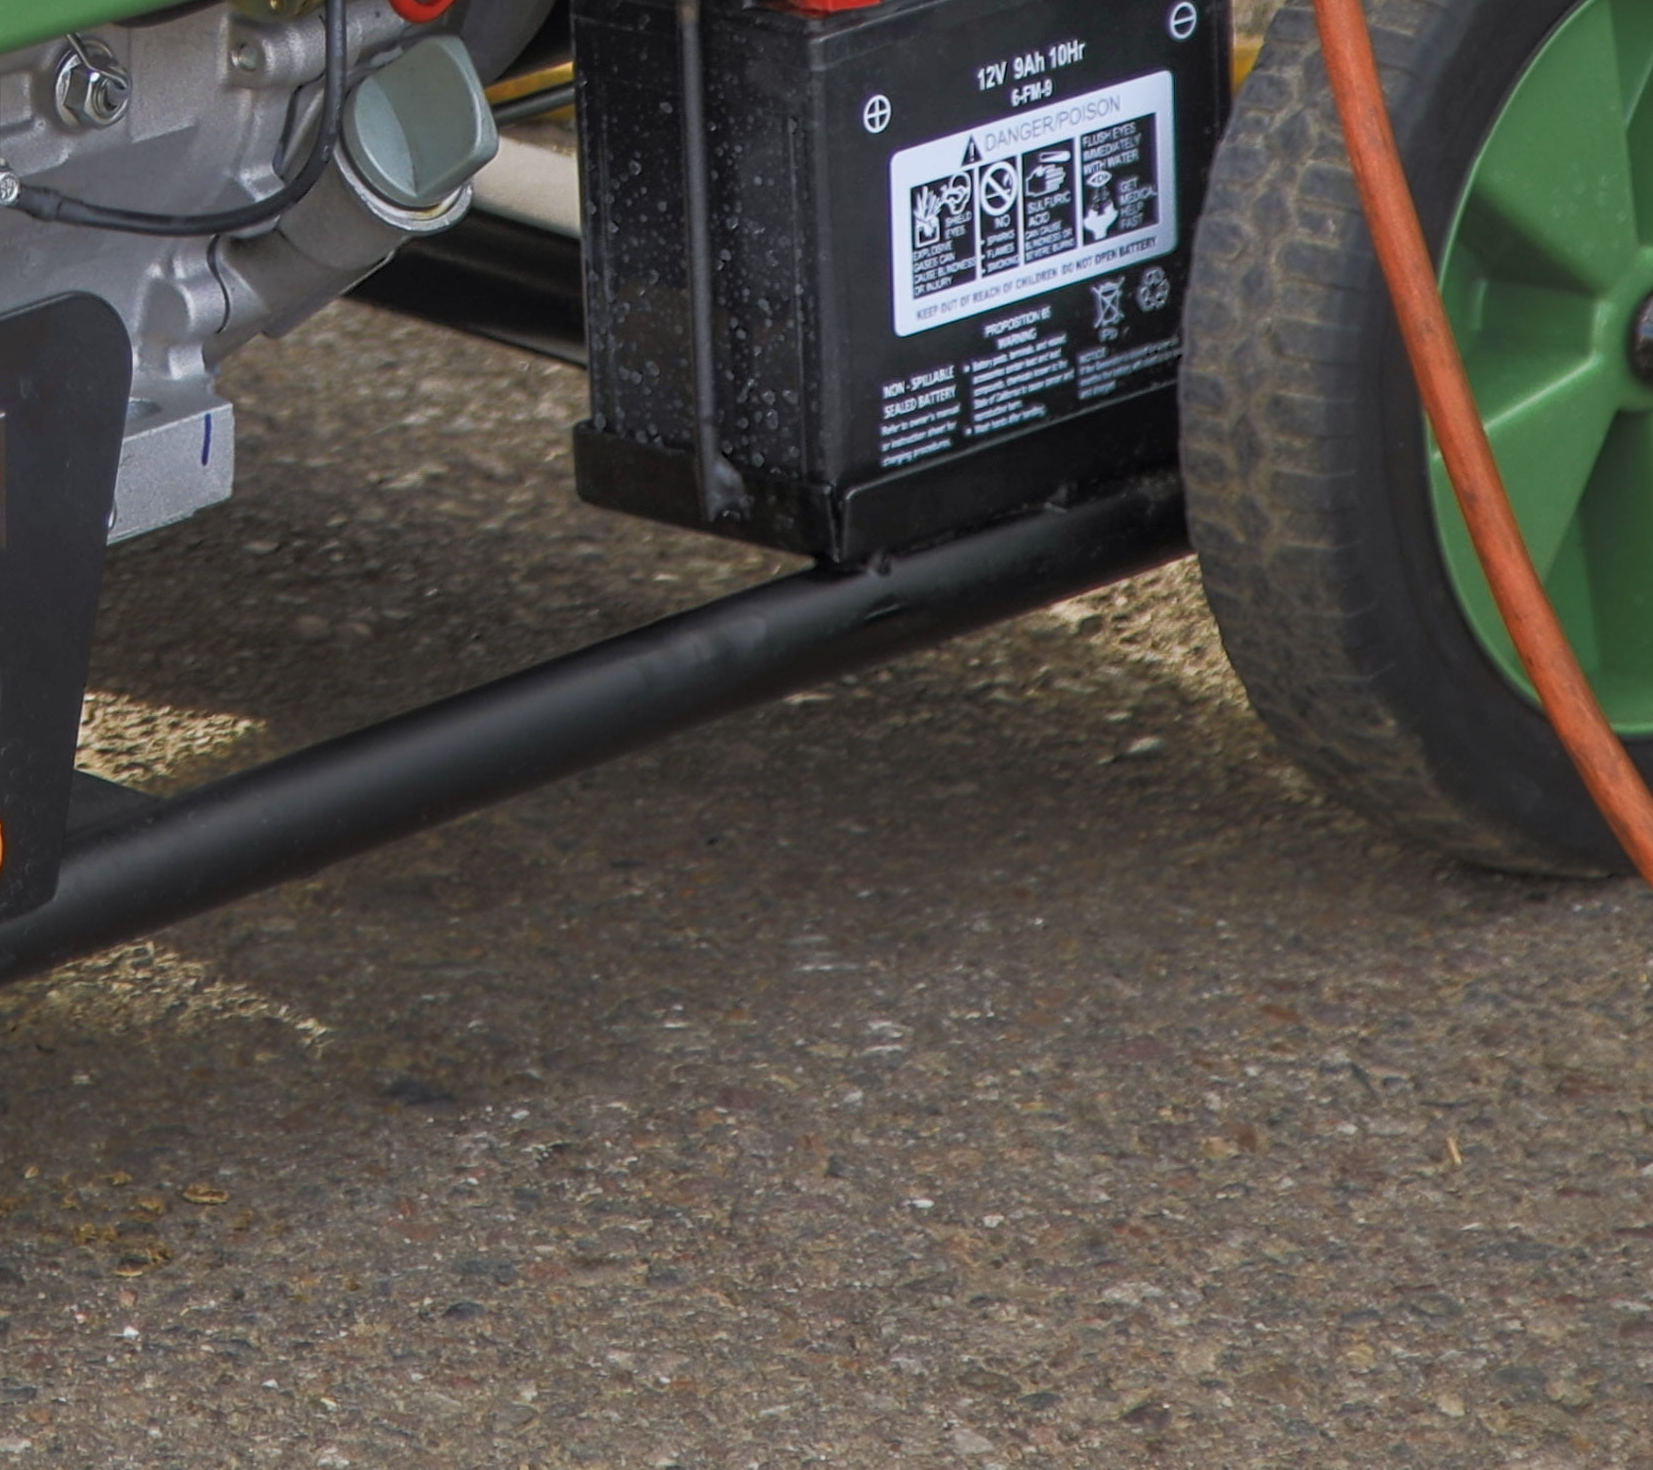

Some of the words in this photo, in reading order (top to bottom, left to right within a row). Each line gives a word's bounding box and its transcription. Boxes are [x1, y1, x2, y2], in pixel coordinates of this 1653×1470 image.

[977, 61, 1007, 91] 12V
[1013, 51, 1044, 80] 9Ah
[1049, 39, 1086, 68] 10Hr
[1011, 79, 1053, 107] 6-FM-9
[985, 95, 1121, 152] DANGER/POISON
[995, 214, 1010, 230] NO
[1095, 250, 1117, 264] OPEN
[1119, 237, 1157, 257] BATTERY
[883, 383, 905, 400] NON
[883, 398, 917, 419] SEALED
[918, 386, 956, 409] BATTERY
